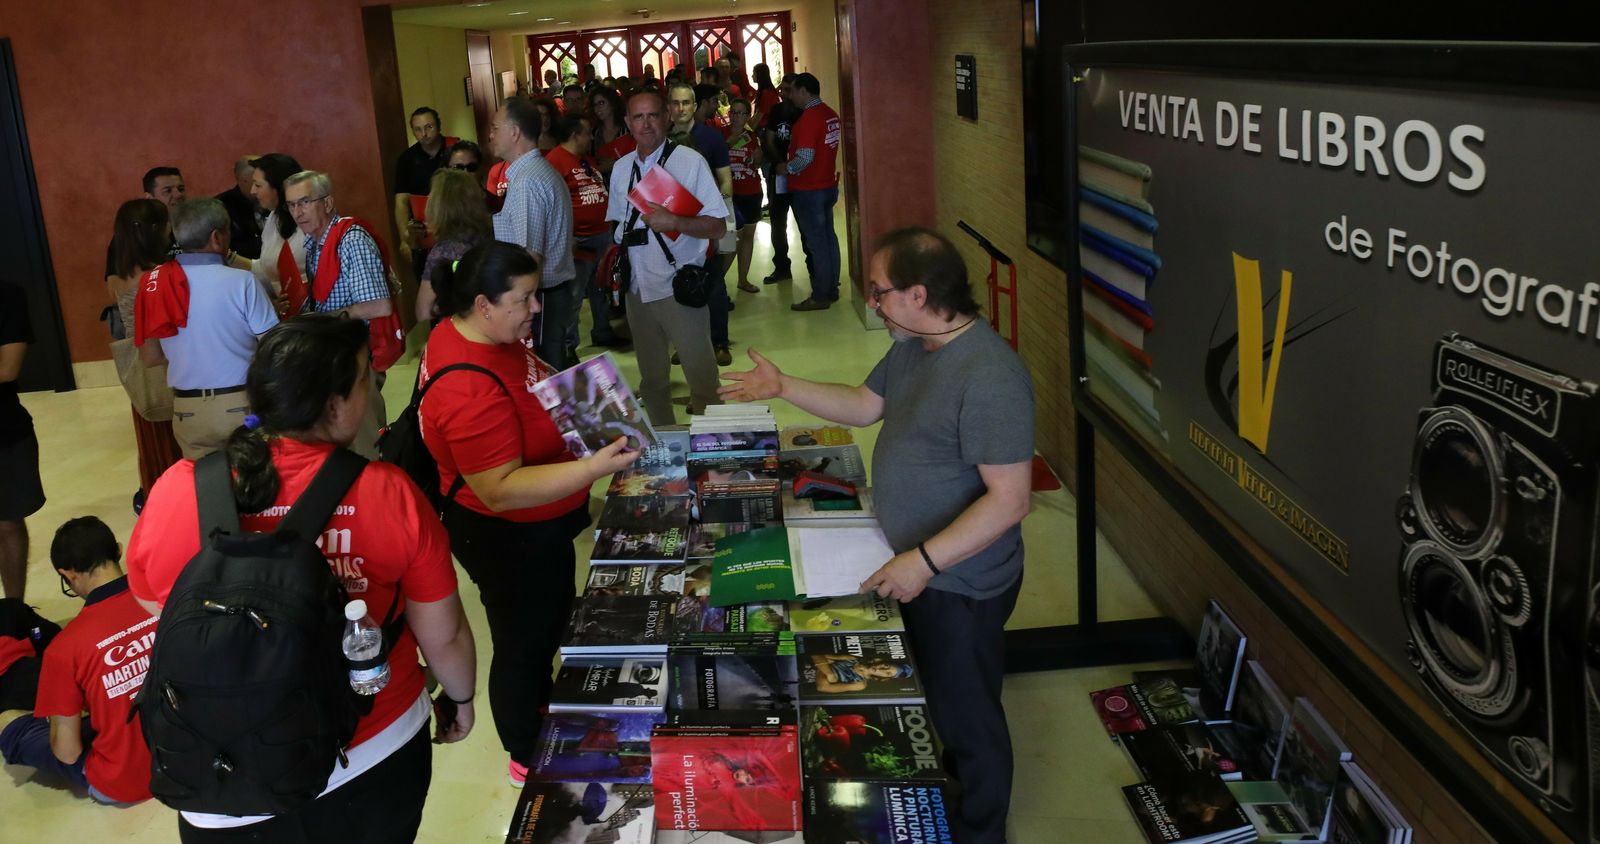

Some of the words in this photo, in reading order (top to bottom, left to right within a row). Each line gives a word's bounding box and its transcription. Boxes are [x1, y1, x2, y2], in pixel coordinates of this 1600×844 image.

[1118, 90, 1204, 143] VENTA
[1215, 100, 1262, 153] DE
[1278, 106, 1487, 191] LIBROS
[1324, 214, 1373, 260] de
[1386, 226, 1600, 340] Fotograf
[1445, 358, 1550, 420] ROLLEIFLEX
[334, 505, 355, 516] 019
[630, 566, 642, 587] BODA
[649, 600, 658, 608] DE
[645, 610, 659, 638] BODAS
[845, 635, 863, 657] PRETTY
[886, 634, 906, 660] STRONG
[705, 668, 716, 708] FOTOGRAFÍA
[902, 706, 938, 769] FOODIE
[683, 754, 694, 768] La
[903, 787, 914, 795] Y
[669, 791, 686, 830] perfect
[888, 787, 908, 842] LUMÍNICA
[904, 797, 924, 844] PINTURA
[1137, 785, 1145, 795] en
[1142, 795, 1174, 841] LIGHTROOM?
[1158, 805, 1172, 824] hacer
[1168, 823, 1180, 839] esto
